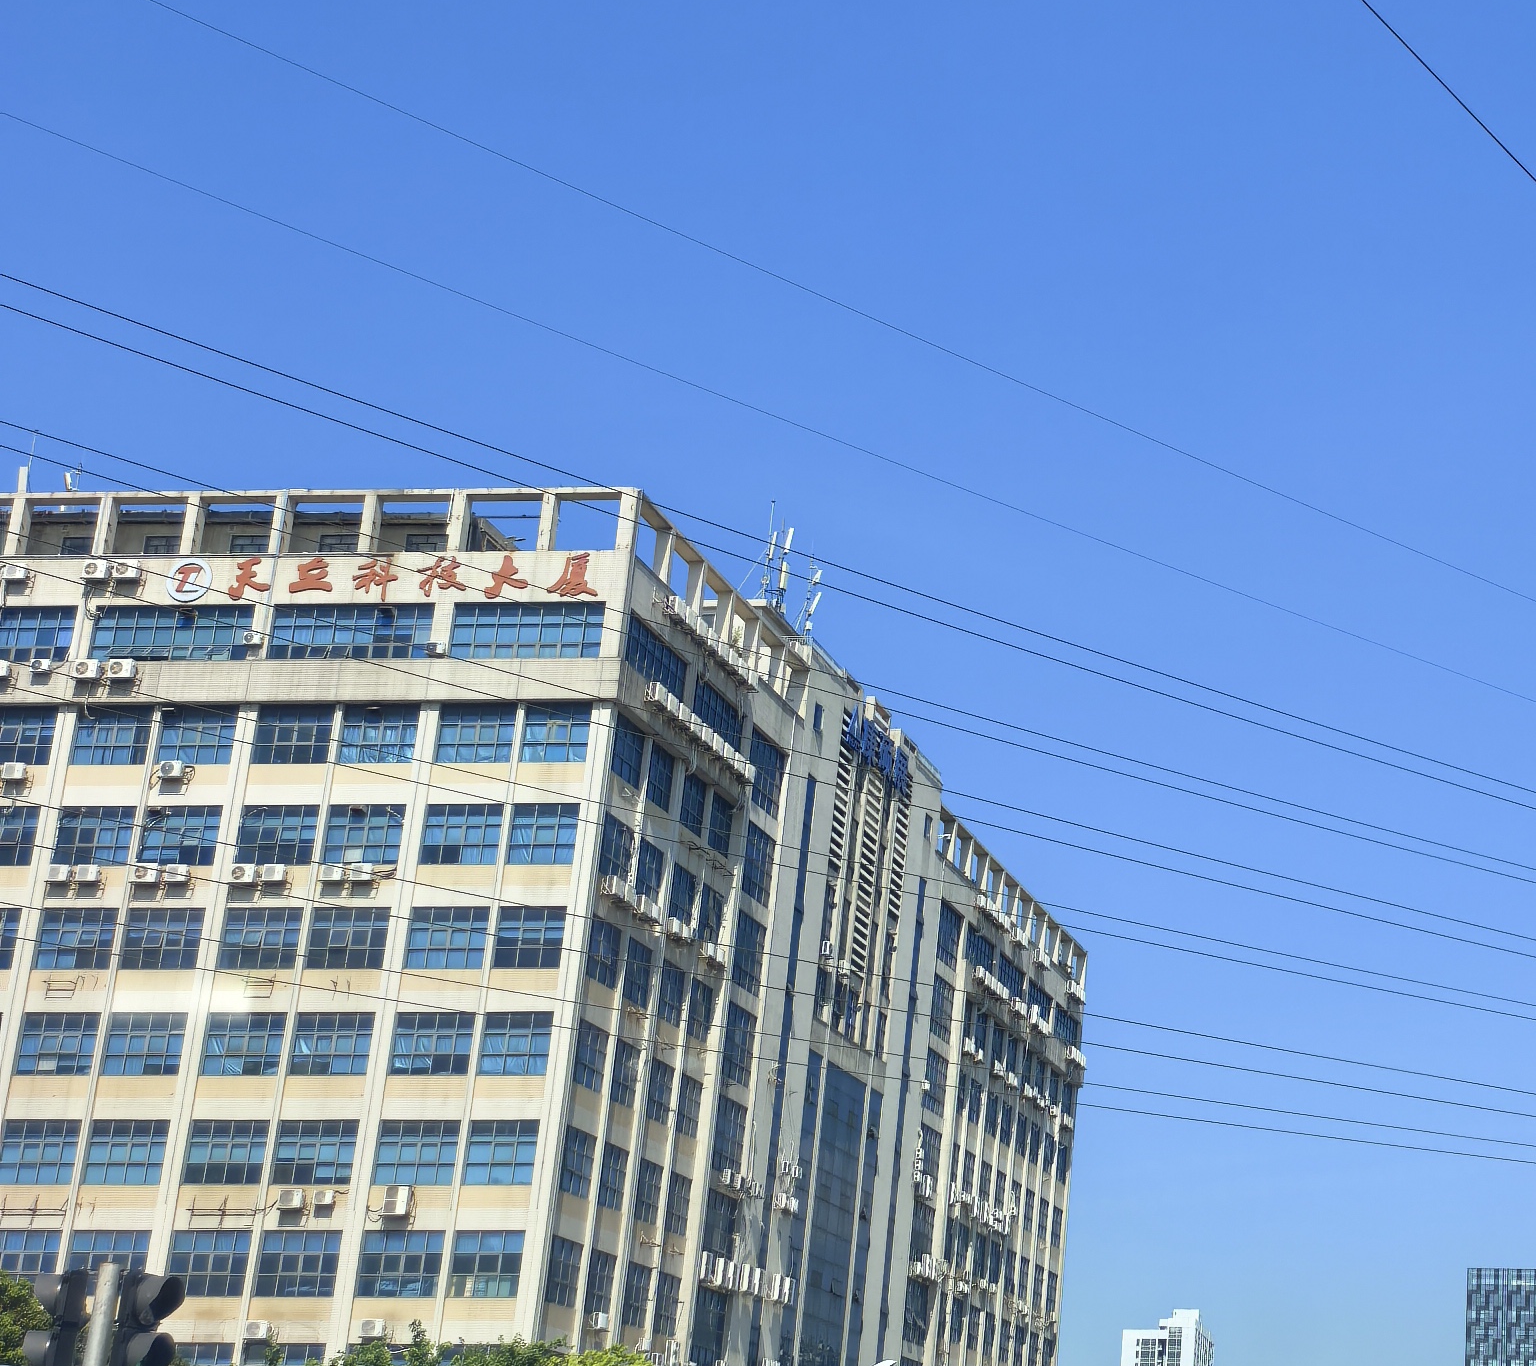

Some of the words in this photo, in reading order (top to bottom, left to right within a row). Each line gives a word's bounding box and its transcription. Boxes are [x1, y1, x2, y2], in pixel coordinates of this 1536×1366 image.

[228, 552, 599, 602] 天立科技大厦
